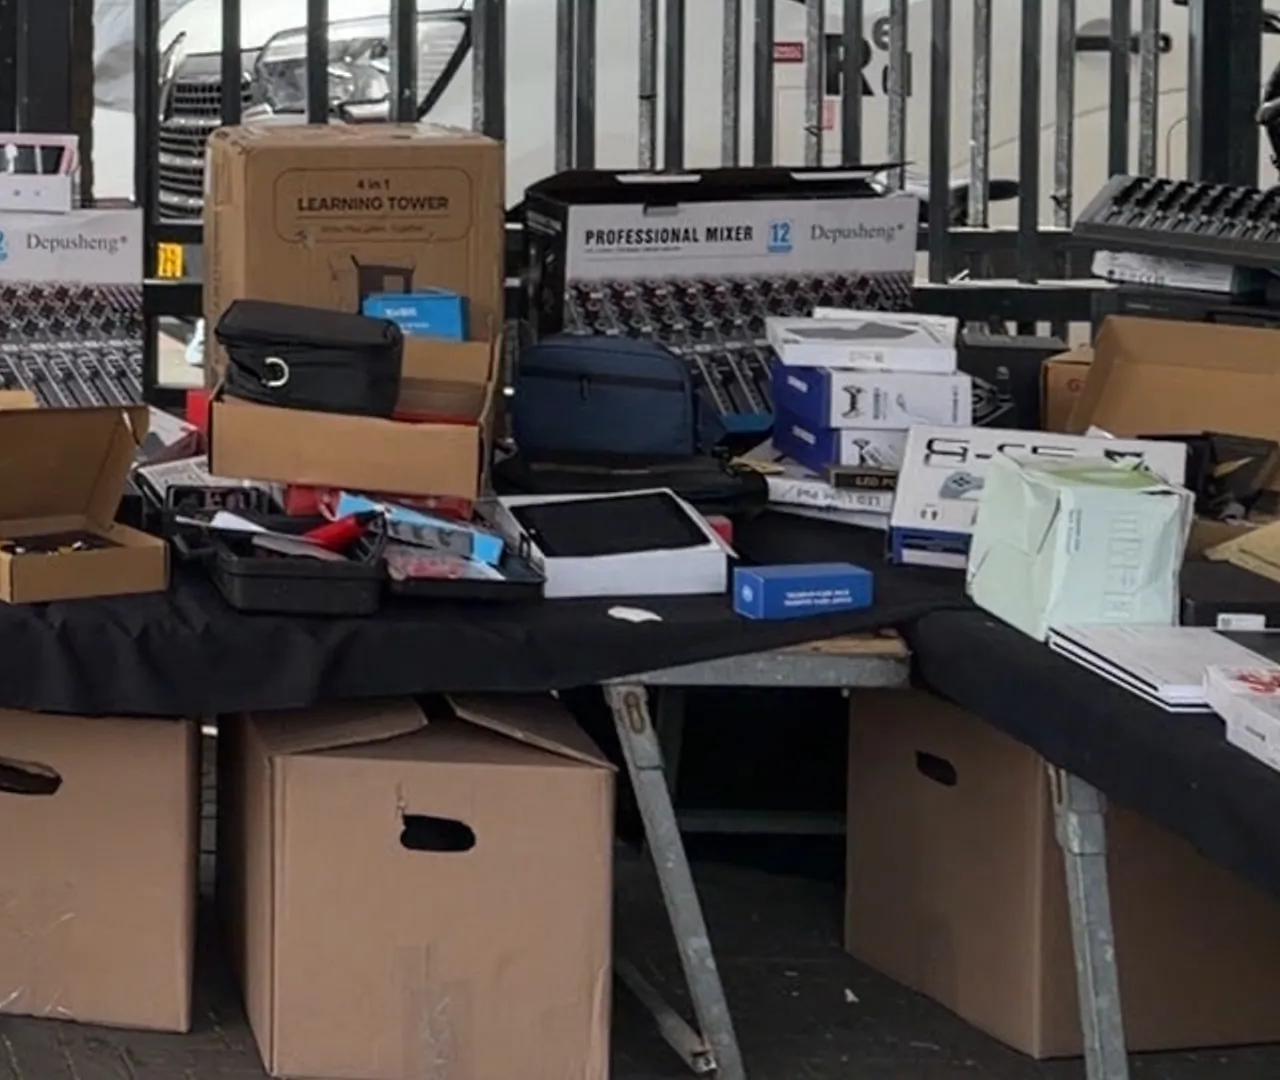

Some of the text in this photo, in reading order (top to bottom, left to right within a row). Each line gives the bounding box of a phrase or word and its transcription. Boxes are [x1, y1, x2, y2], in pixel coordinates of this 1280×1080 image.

[297, 195, 449, 212] LEARNING TOWER
[585, 225, 754, 246] PROFESSIONAL MIXER
[771, 222, 791, 244] 12
